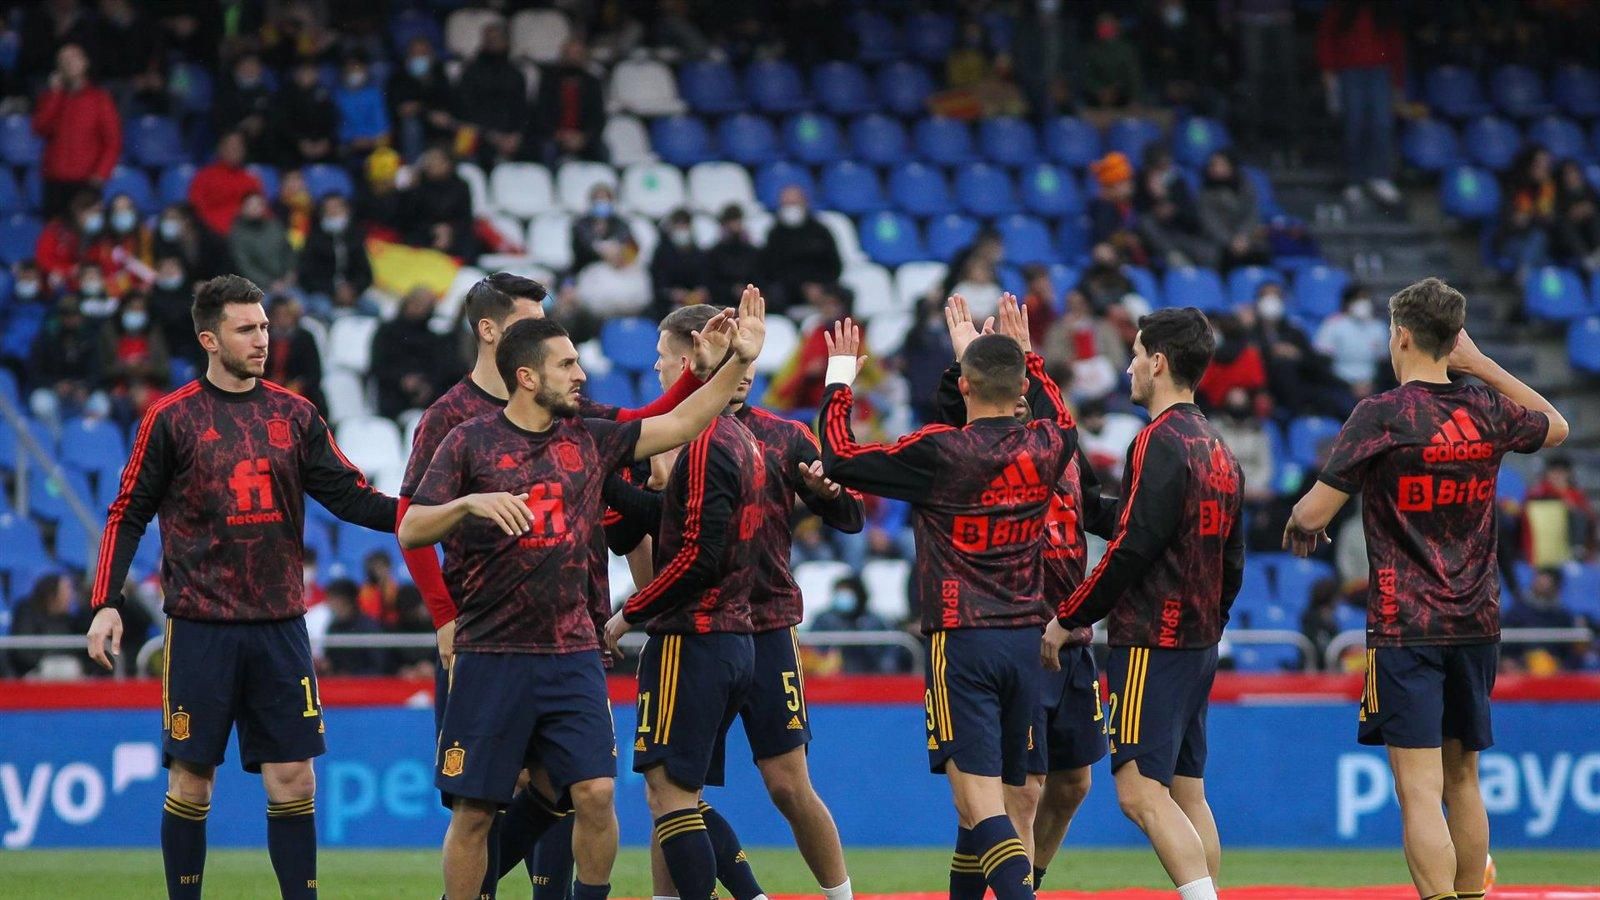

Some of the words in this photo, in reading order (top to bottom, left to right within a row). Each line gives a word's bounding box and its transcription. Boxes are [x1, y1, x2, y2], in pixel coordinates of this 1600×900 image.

[1422, 440, 1493, 463] adidas
[981, 482, 1049, 507] adidas
[226, 511, 284, 527] network
[781, 671, 800, 712] 5
